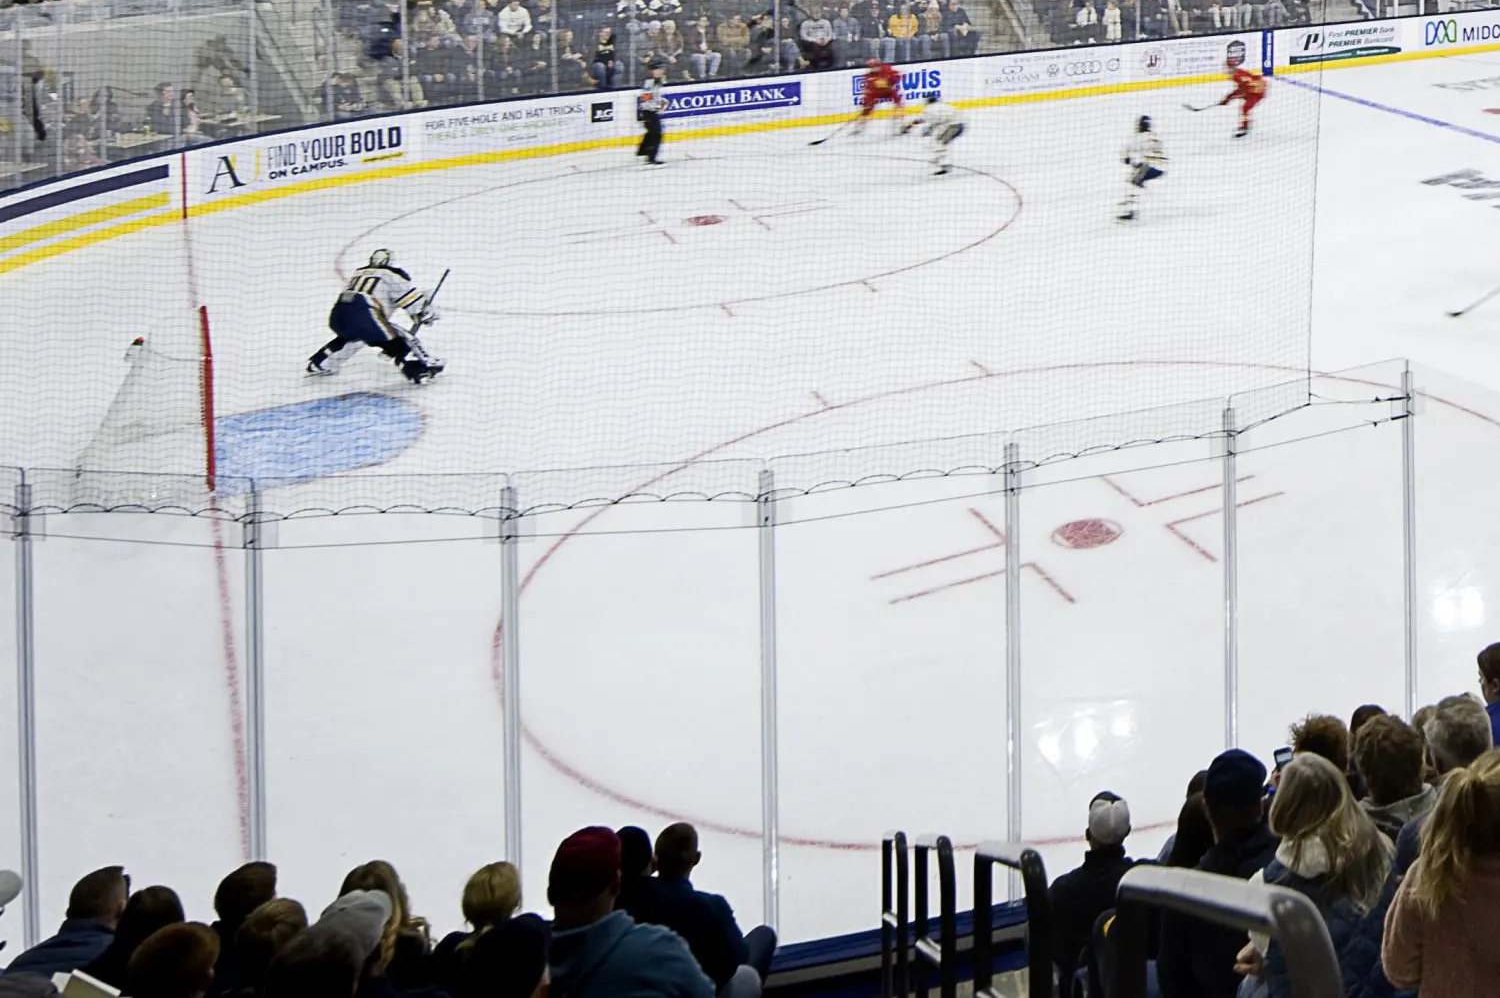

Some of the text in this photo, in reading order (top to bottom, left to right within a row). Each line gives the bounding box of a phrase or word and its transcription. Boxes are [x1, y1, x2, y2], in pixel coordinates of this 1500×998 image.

[1344, 27, 1379, 37] PREMIER
[1328, 39, 1362, 48] PREMIER
[740, 87, 786, 104] BANK
[501, 110, 522, 121] AND
[526, 107, 545, 118] HAT
[267, 143, 297, 170] FIND
[300, 134, 346, 163] YOUR
[350, 126, 402, 155] BOLD
[268, 169, 288, 180] ON
